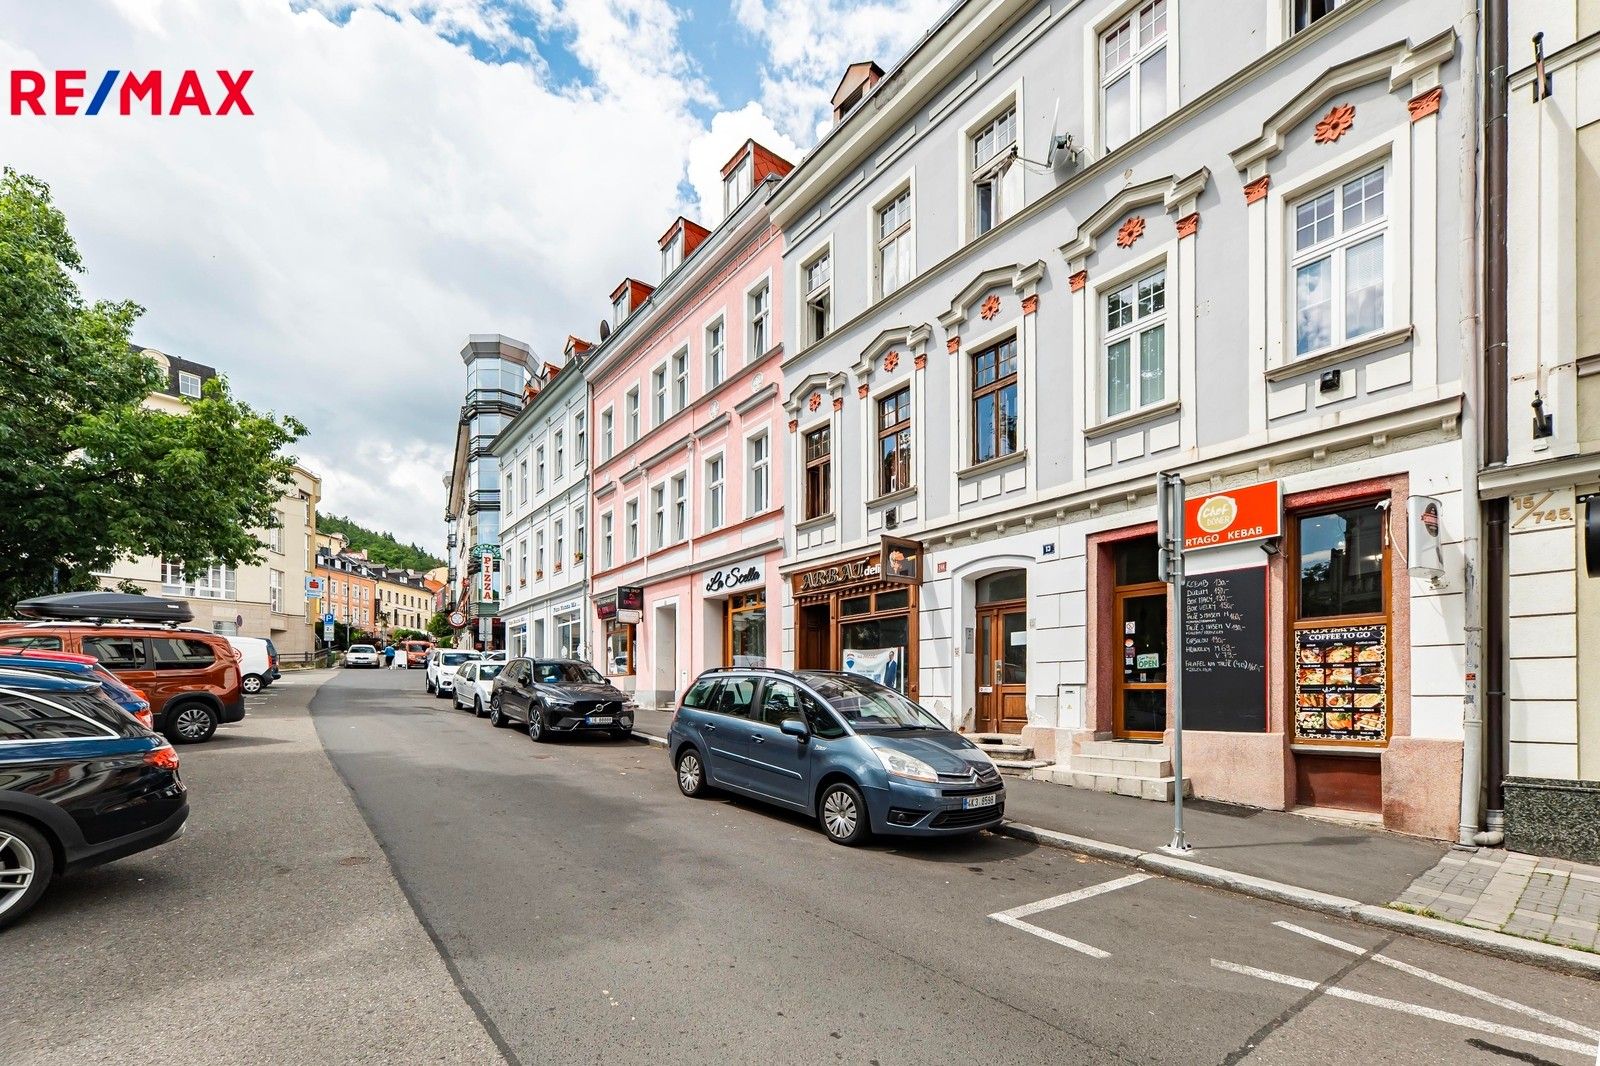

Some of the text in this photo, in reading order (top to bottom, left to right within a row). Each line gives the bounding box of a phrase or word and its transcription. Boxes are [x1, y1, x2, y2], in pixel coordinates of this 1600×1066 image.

[1203, 504, 1230, 517] Chef
[1186, 526, 1263, 546] RTAGO KEBAB
[864, 564, 881, 576] deli
